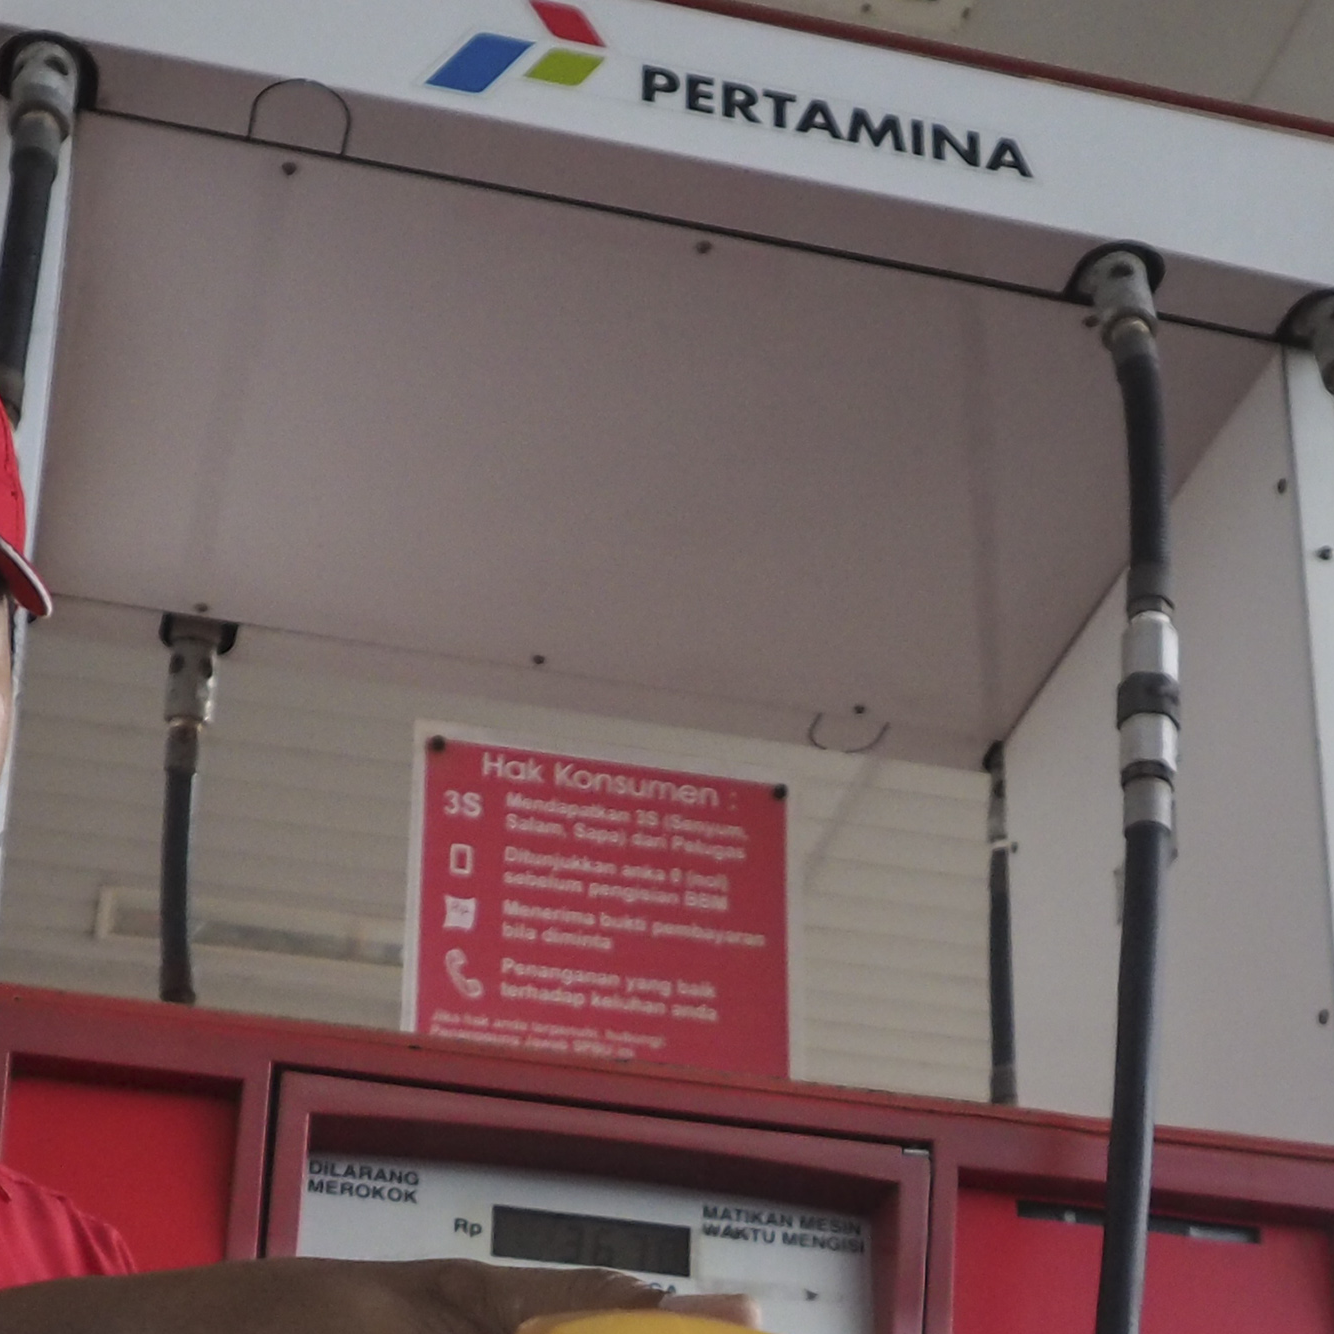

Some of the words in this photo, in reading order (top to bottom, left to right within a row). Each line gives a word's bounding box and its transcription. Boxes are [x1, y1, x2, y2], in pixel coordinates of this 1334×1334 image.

[641, 64, 1034, 178] PERTAMINA
[483, 751, 543, 784] Hak
[554, 762, 718, 808] Konsumen
[443, 789, 482, 819] 3S
[501, 958, 620, 990] Penanganan
[625, 977, 671, 996] yang
[308, 1160, 419, 1186] DILARANG
[307, 1178, 417, 1203] MEROKOK
[454, 1218, 482, 1237] Rp
[702, 1205, 793, 1228] MATIKAN
[799, 1214, 861, 1236] MESIN
[702, 1222, 776, 1245] WAKTU
[782, 1231, 865, 1254] MENGISI
